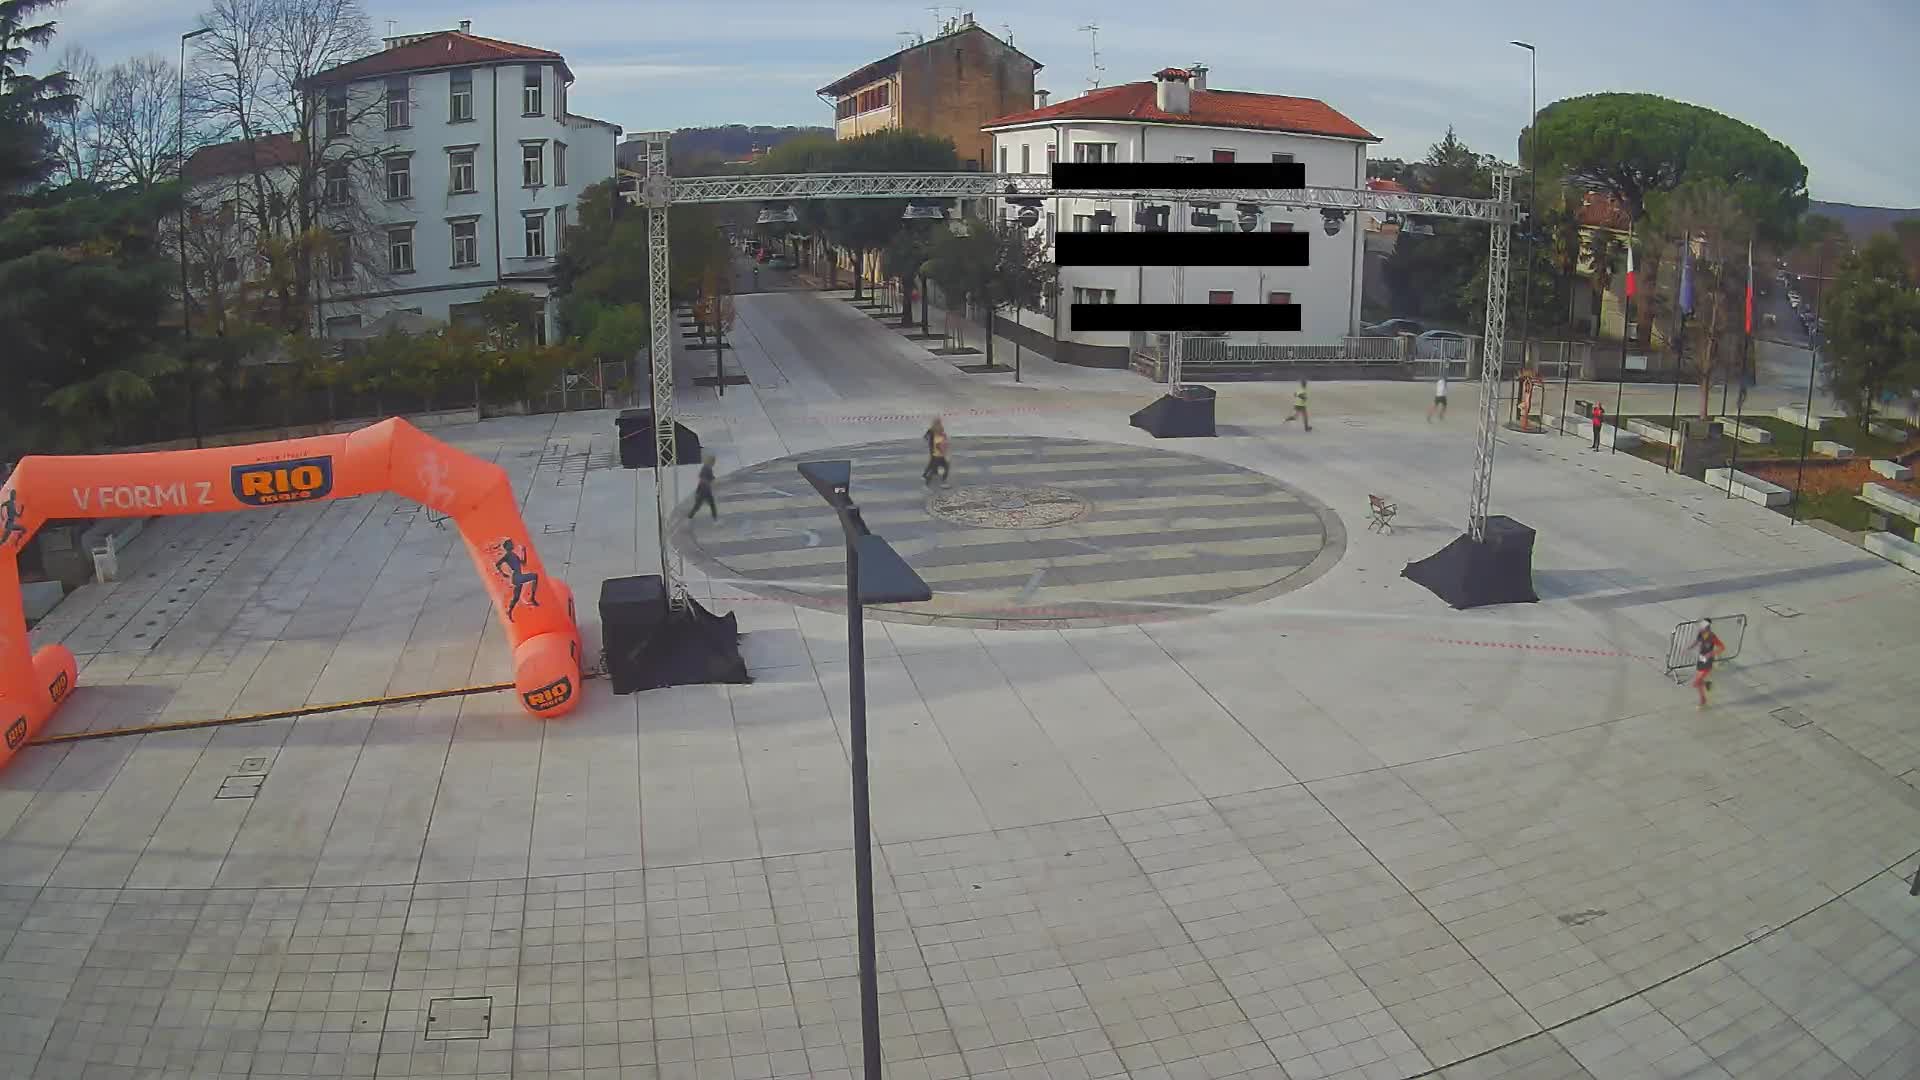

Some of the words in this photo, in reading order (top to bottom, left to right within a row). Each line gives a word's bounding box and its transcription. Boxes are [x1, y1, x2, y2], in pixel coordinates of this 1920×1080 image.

[242, 465, 324, 496] RIO
[72, 487, 91, 510] V
[99, 481, 187, 509] FORMI
[194, 481, 215, 505] Z
[528, 683, 568, 706] RIO
